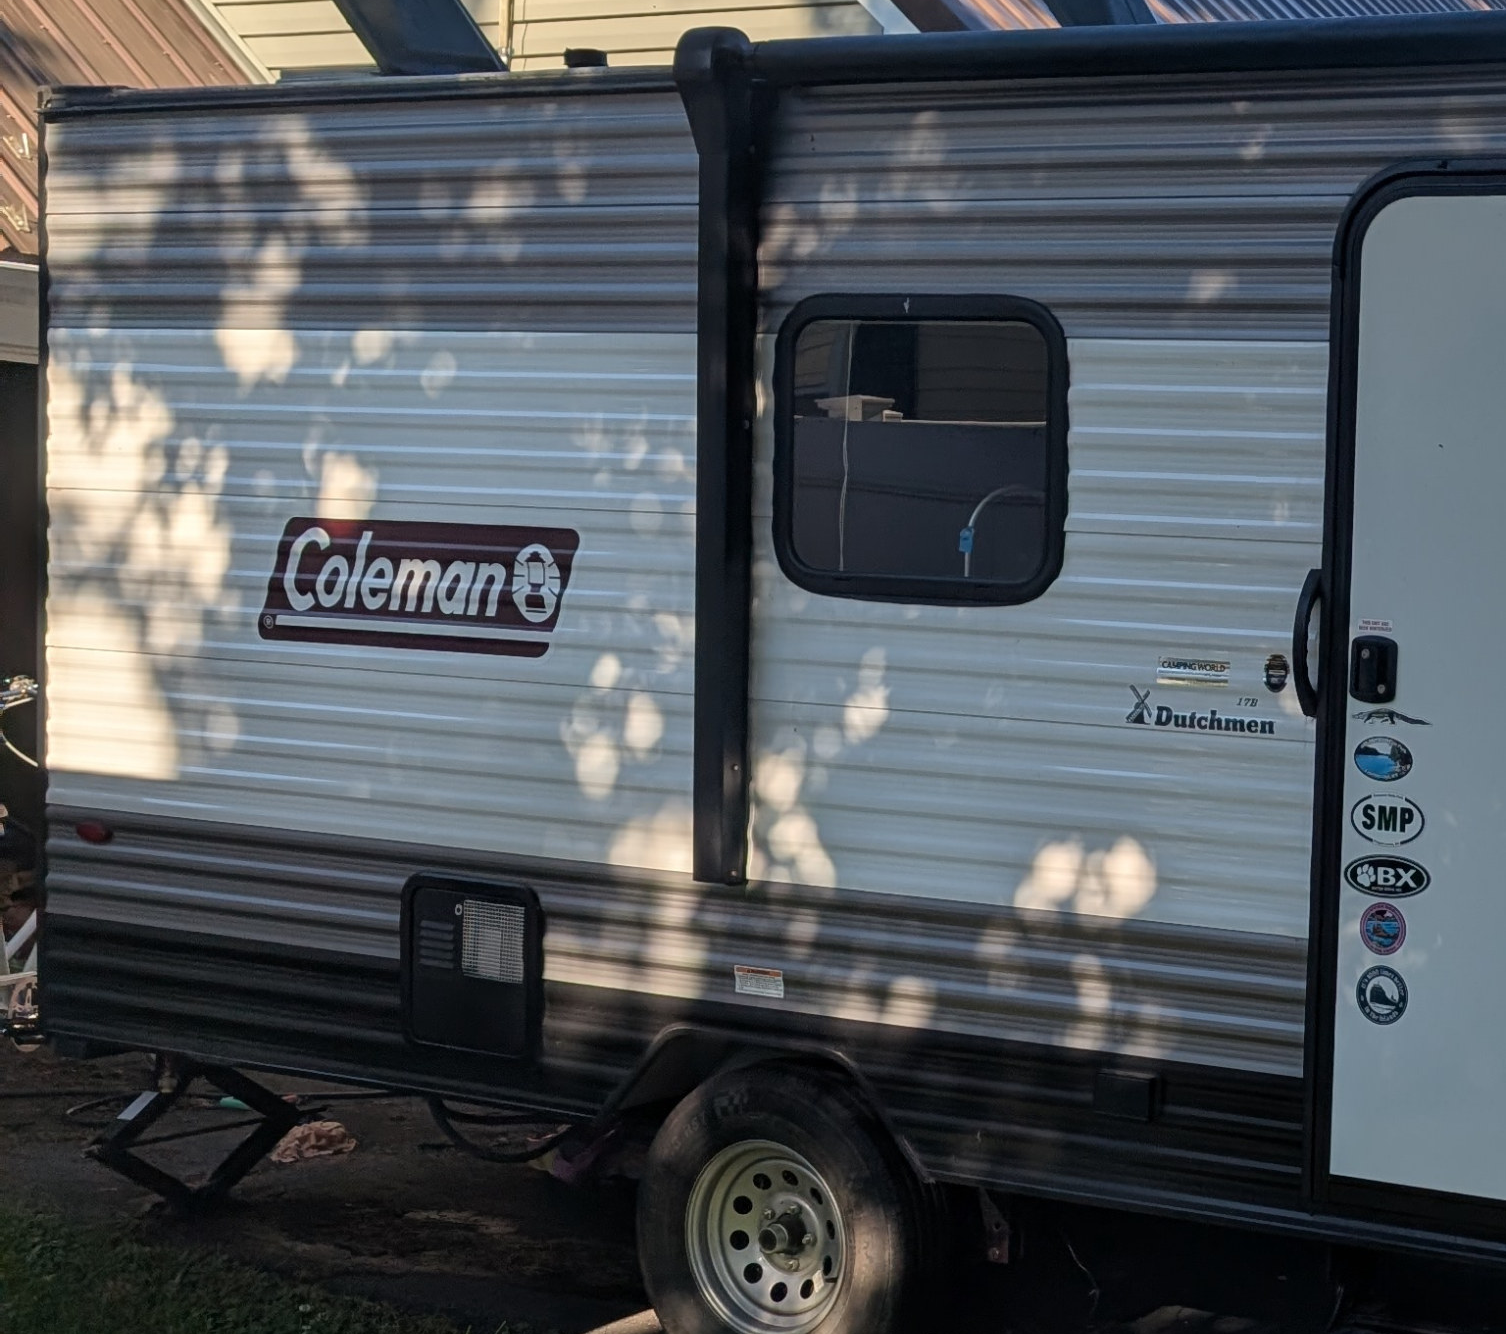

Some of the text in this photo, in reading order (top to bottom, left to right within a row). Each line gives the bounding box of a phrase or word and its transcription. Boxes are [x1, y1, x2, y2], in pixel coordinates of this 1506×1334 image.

[283, 527, 506, 617] Coleman
[1162, 660, 1226, 672] CAMPING WORLD
[1154, 705, 1275, 734] Dutchmen
[1362, 803, 1414, 833] SMP
